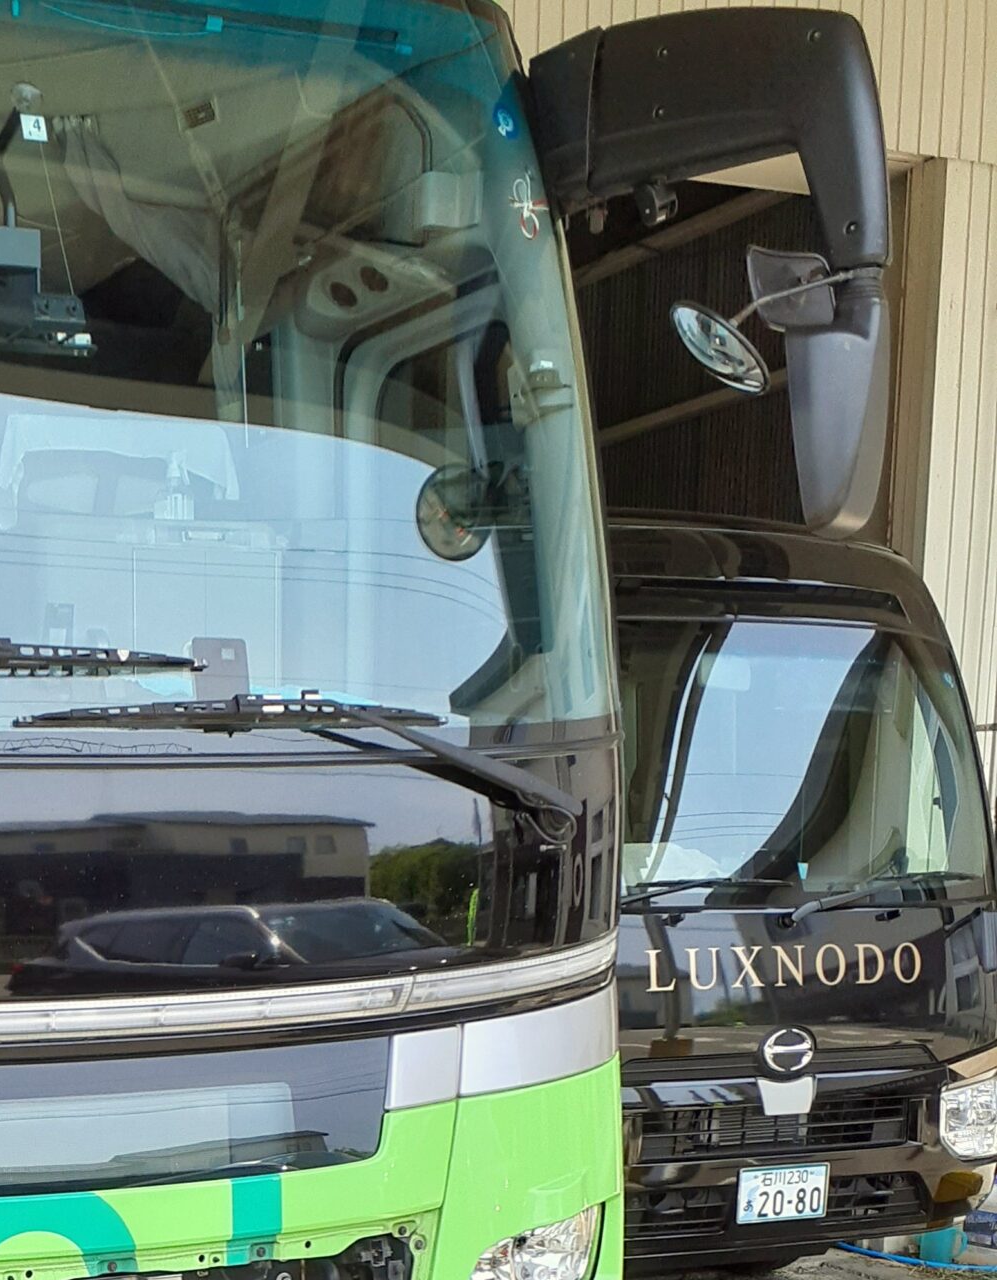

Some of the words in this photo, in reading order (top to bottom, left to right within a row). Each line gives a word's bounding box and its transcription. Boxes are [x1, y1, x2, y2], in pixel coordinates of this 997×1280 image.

[645, 942, 923, 993] LUXNODO
[761, 1170, 809, 1186] 石川230
[757, 1187, 821, 1217] 20-80
